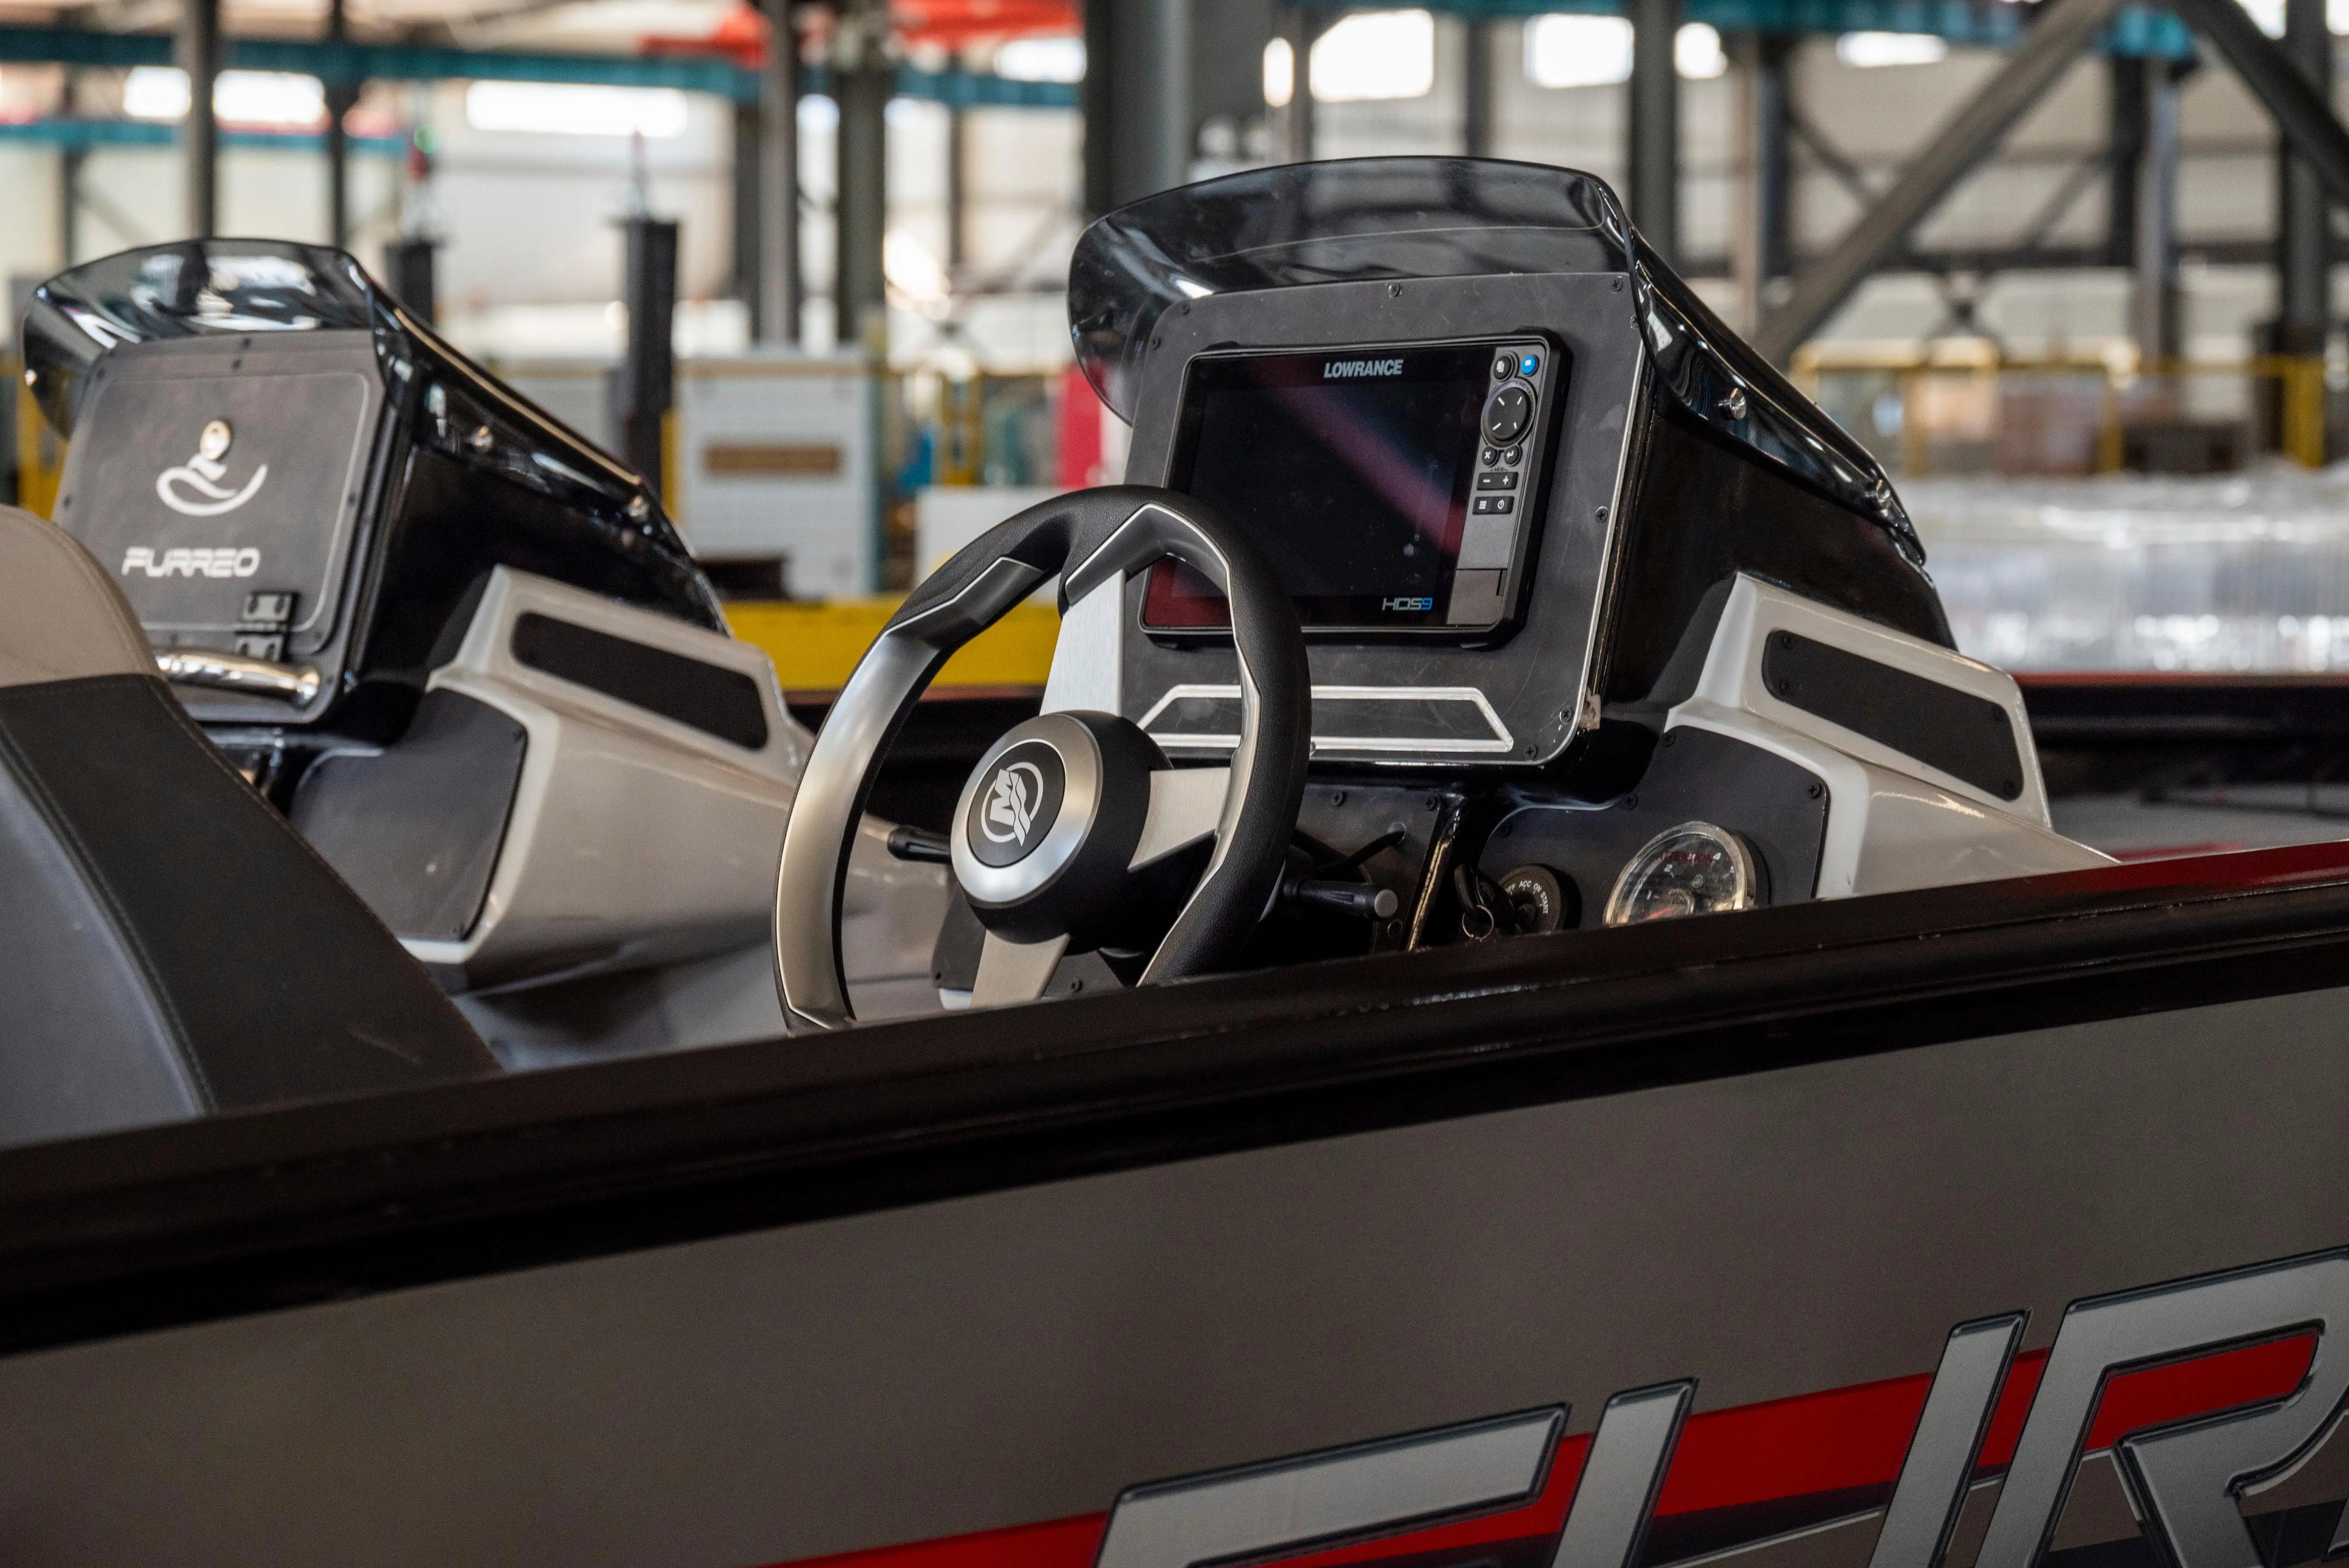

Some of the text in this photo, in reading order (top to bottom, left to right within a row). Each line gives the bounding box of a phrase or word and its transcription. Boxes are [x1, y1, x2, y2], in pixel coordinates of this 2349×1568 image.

[1323, 359, 1404, 378] LOWRANCE
[122, 546, 260, 578] FURREO
[1382, 597, 1433, 611] HDS9
[1664, 864, 1672, 872] 2
[1534, 883, 1543, 893] ON
[1540, 891, 1549, 915] START
